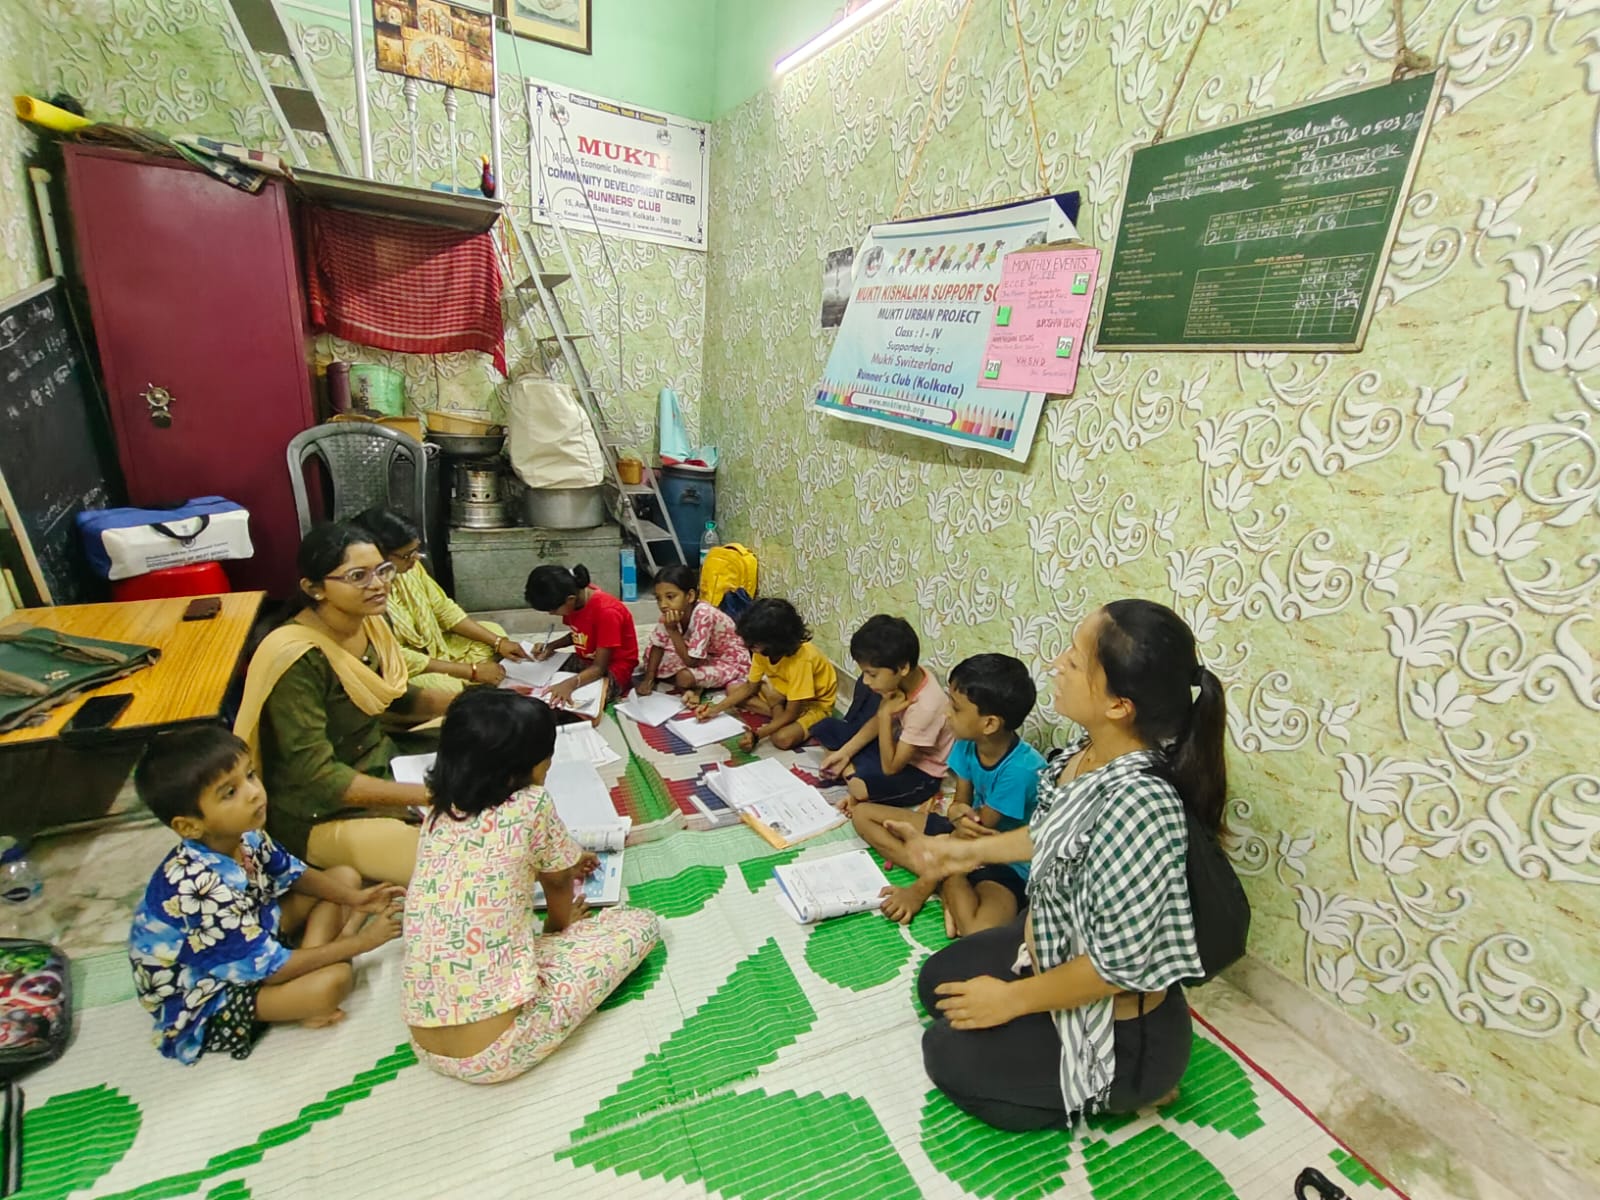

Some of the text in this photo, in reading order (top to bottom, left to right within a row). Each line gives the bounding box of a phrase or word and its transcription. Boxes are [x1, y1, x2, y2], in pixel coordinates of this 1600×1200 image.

[577, 136, 671, 171] MUKTI
[581, 158, 612, 172] Economic
[612, 164, 653, 179] Developmen
[587, 189, 661, 213] RUNNERS' CLUB
[604, 178, 664, 199] DEVELOPMENT
[665, 191, 696, 206] CENTER
[575, 200, 590, 210] Ama
[633, 211, 655, 222] Kolkata
[1011, 257, 1088, 272] MONTHLY EVENTS
[855, 286, 881, 301] MUKTI
[881, 284, 930, 301] KISHALAYA
[931, 283, 983, 301] SUPPORT
[878, 308, 981, 324] MUKTI URBAN PROJECT
[895, 326, 913, 338] Class
[931, 328, 943, 340] IV
[887, 340, 922, 353] Supported
[924, 343, 936, 356] by
[871, 353, 954, 374] Mukti Switzerland
[856, 367, 965, 400] Runner's Club (Kolkata)
